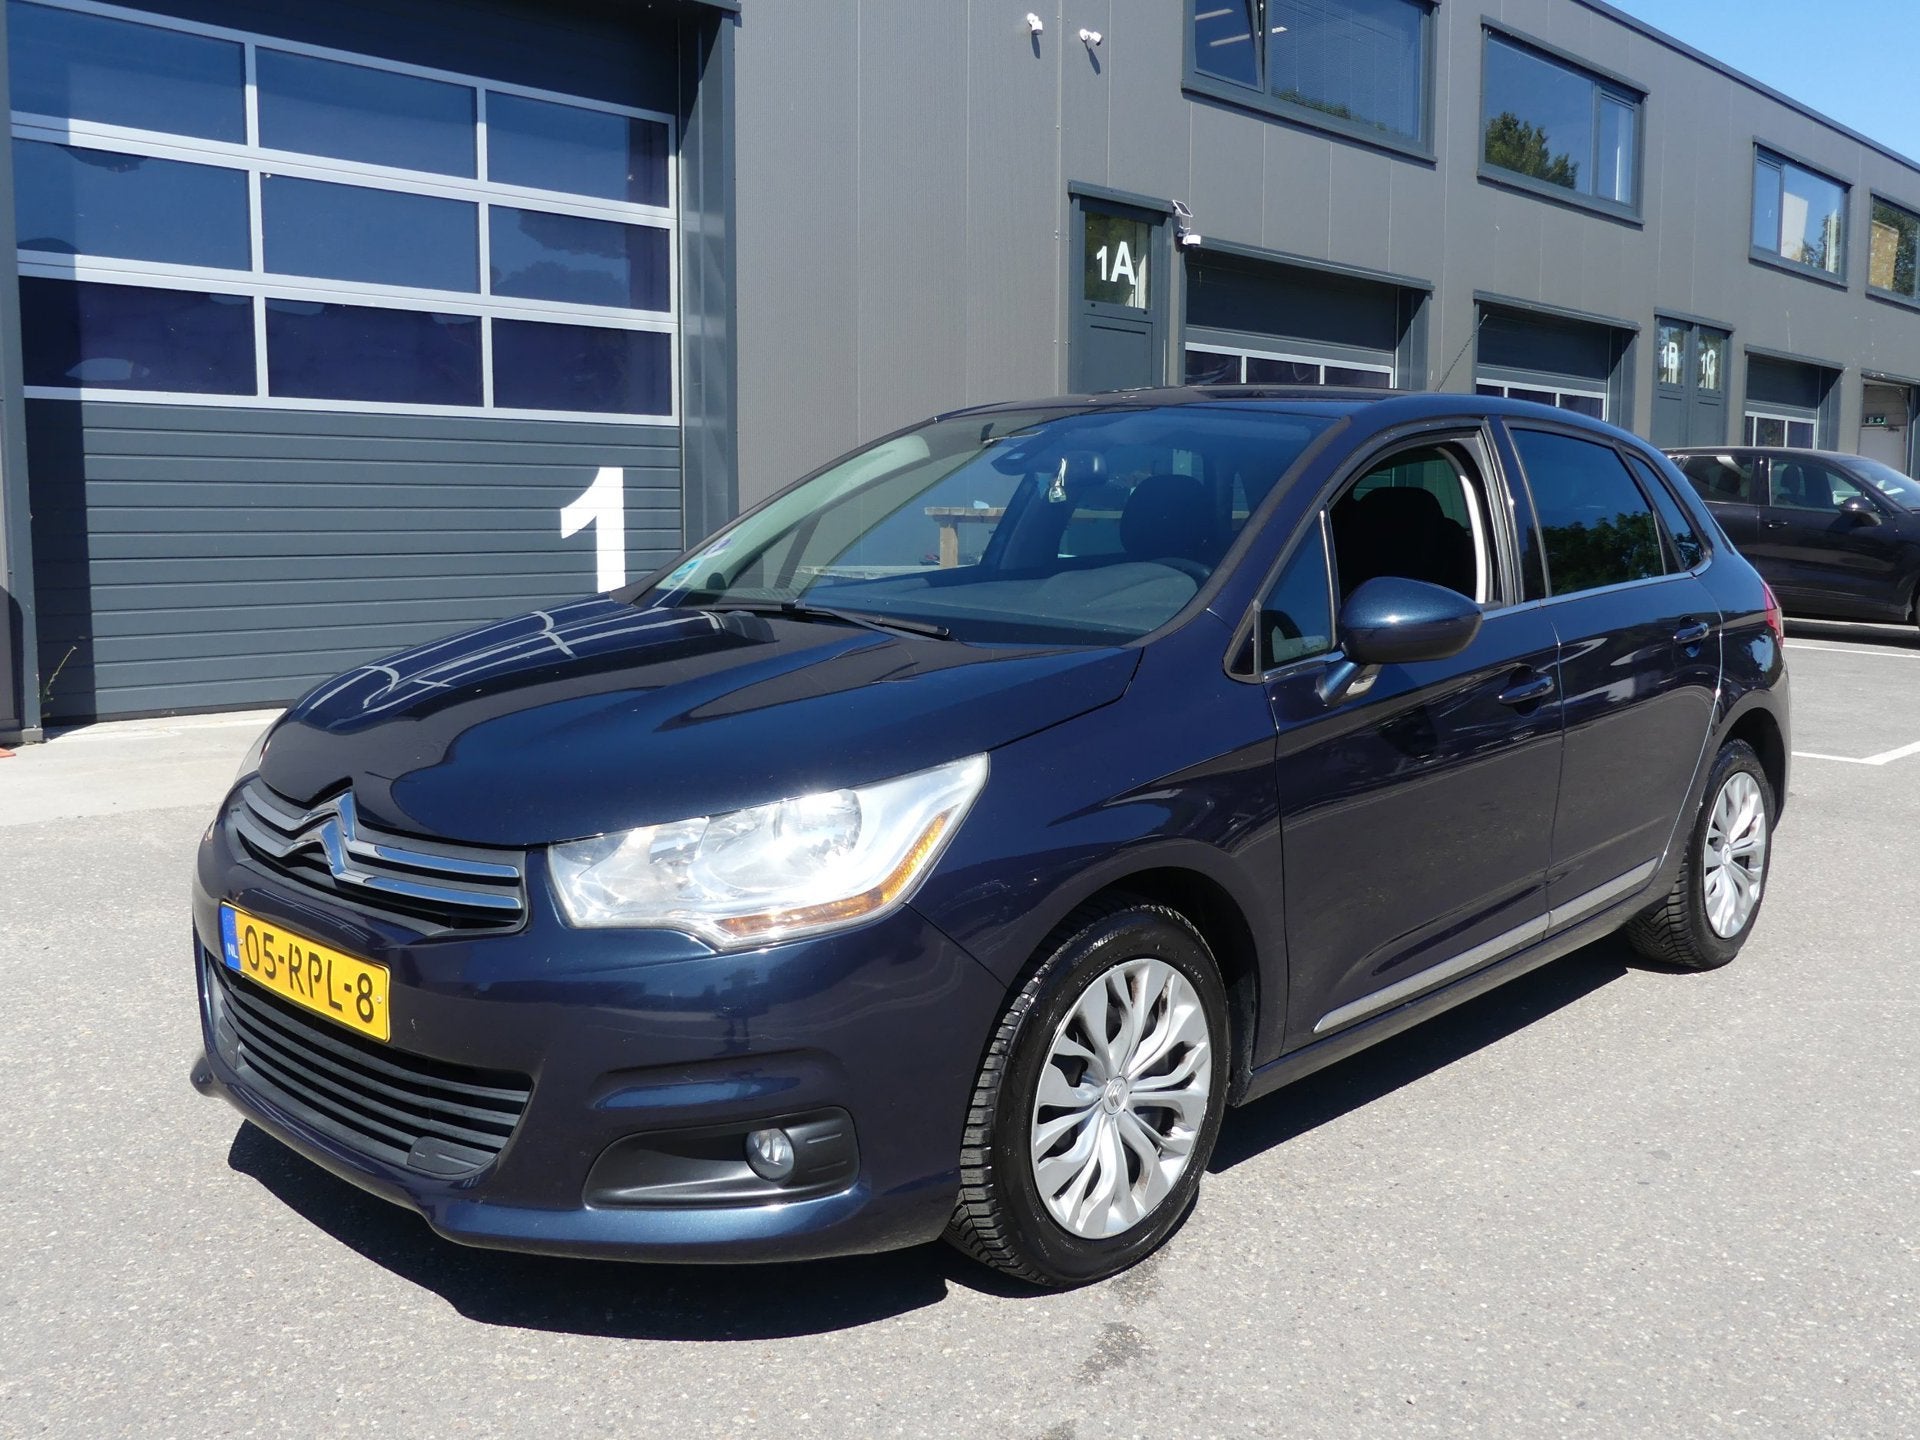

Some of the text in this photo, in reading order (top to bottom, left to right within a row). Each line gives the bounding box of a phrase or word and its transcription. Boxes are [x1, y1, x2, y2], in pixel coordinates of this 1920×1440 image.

[1096, 241, 1136, 286] 1A
[1662, 341, 1678, 370] 1B
[560, 466, 626, 594] 1
[228, 943, 239, 959] NL
[245, 924, 375, 1024] 05-RPL-8
